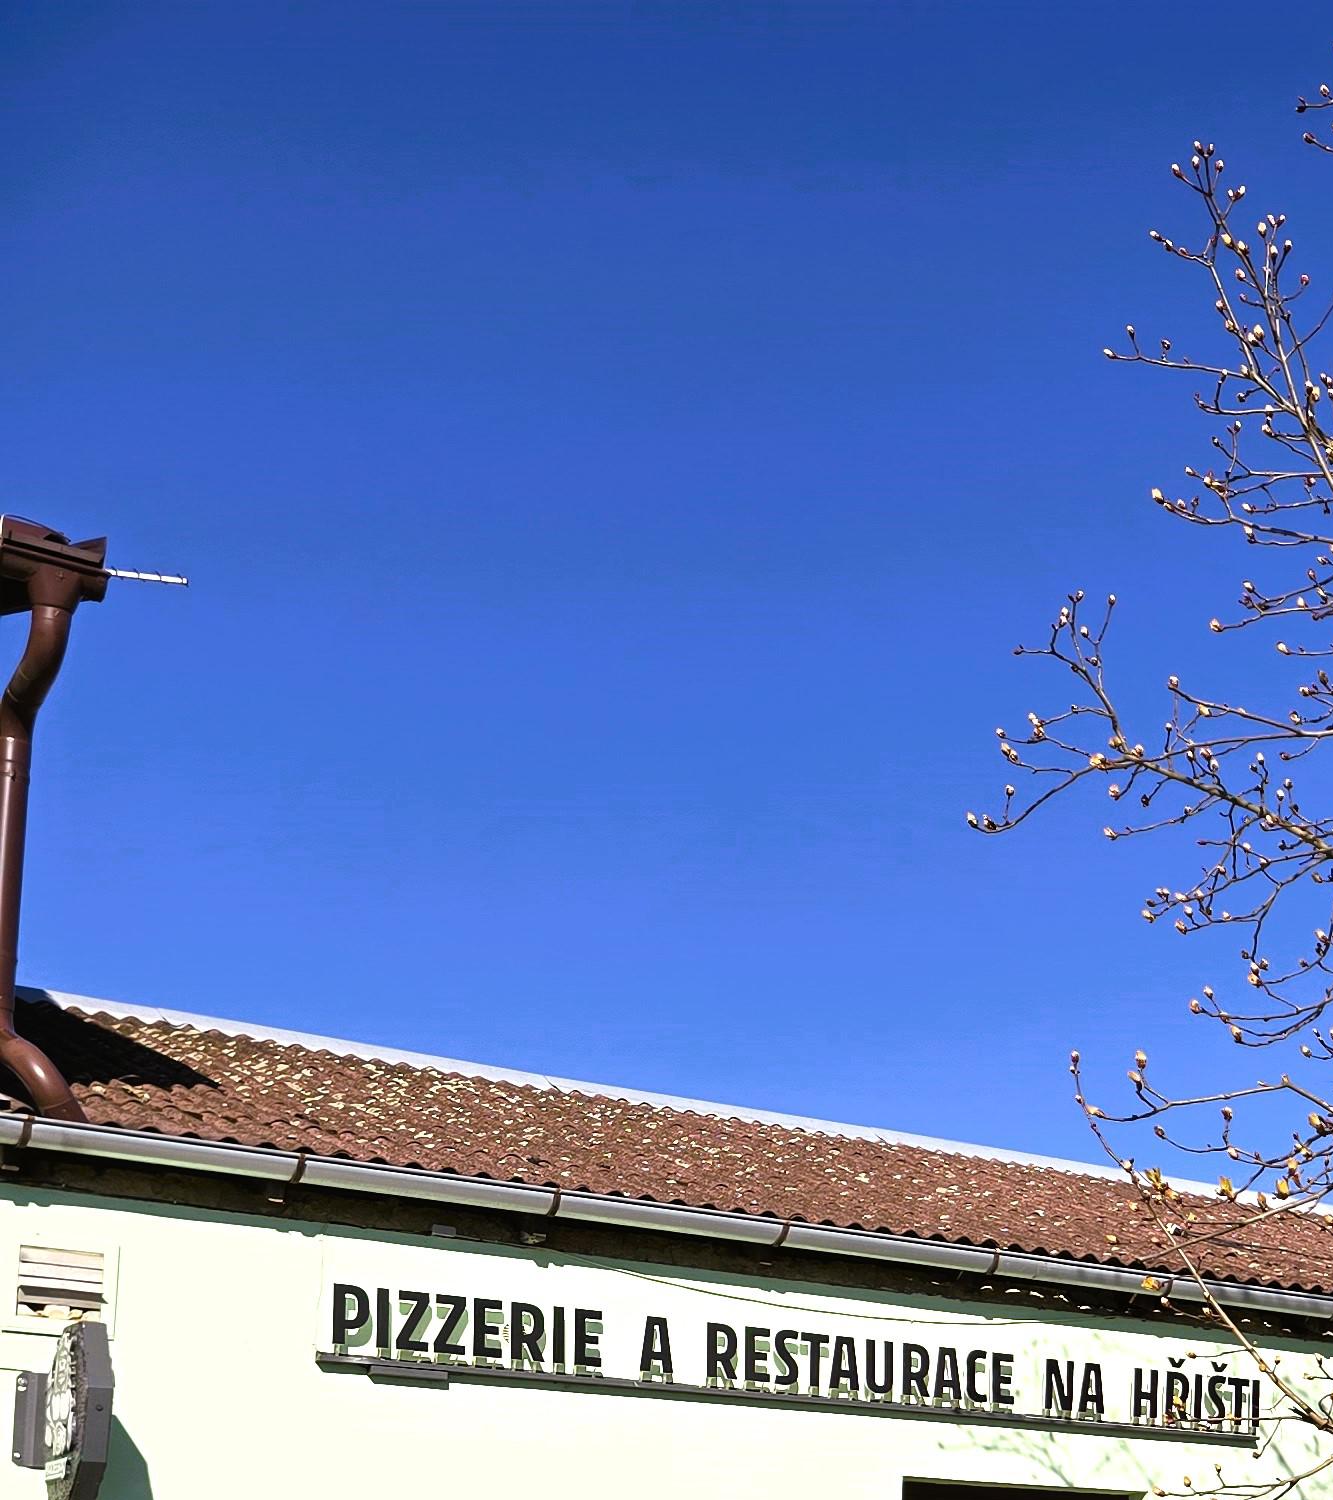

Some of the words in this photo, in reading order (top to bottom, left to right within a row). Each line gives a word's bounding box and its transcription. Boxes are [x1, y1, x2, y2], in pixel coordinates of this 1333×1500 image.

[332, 1283, 602, 1368] PIZZERIE
[639, 1315, 674, 1374] A
[706, 1321, 1014, 1405] RESTAURACE
[1045, 1358, 1104, 1415] NA
